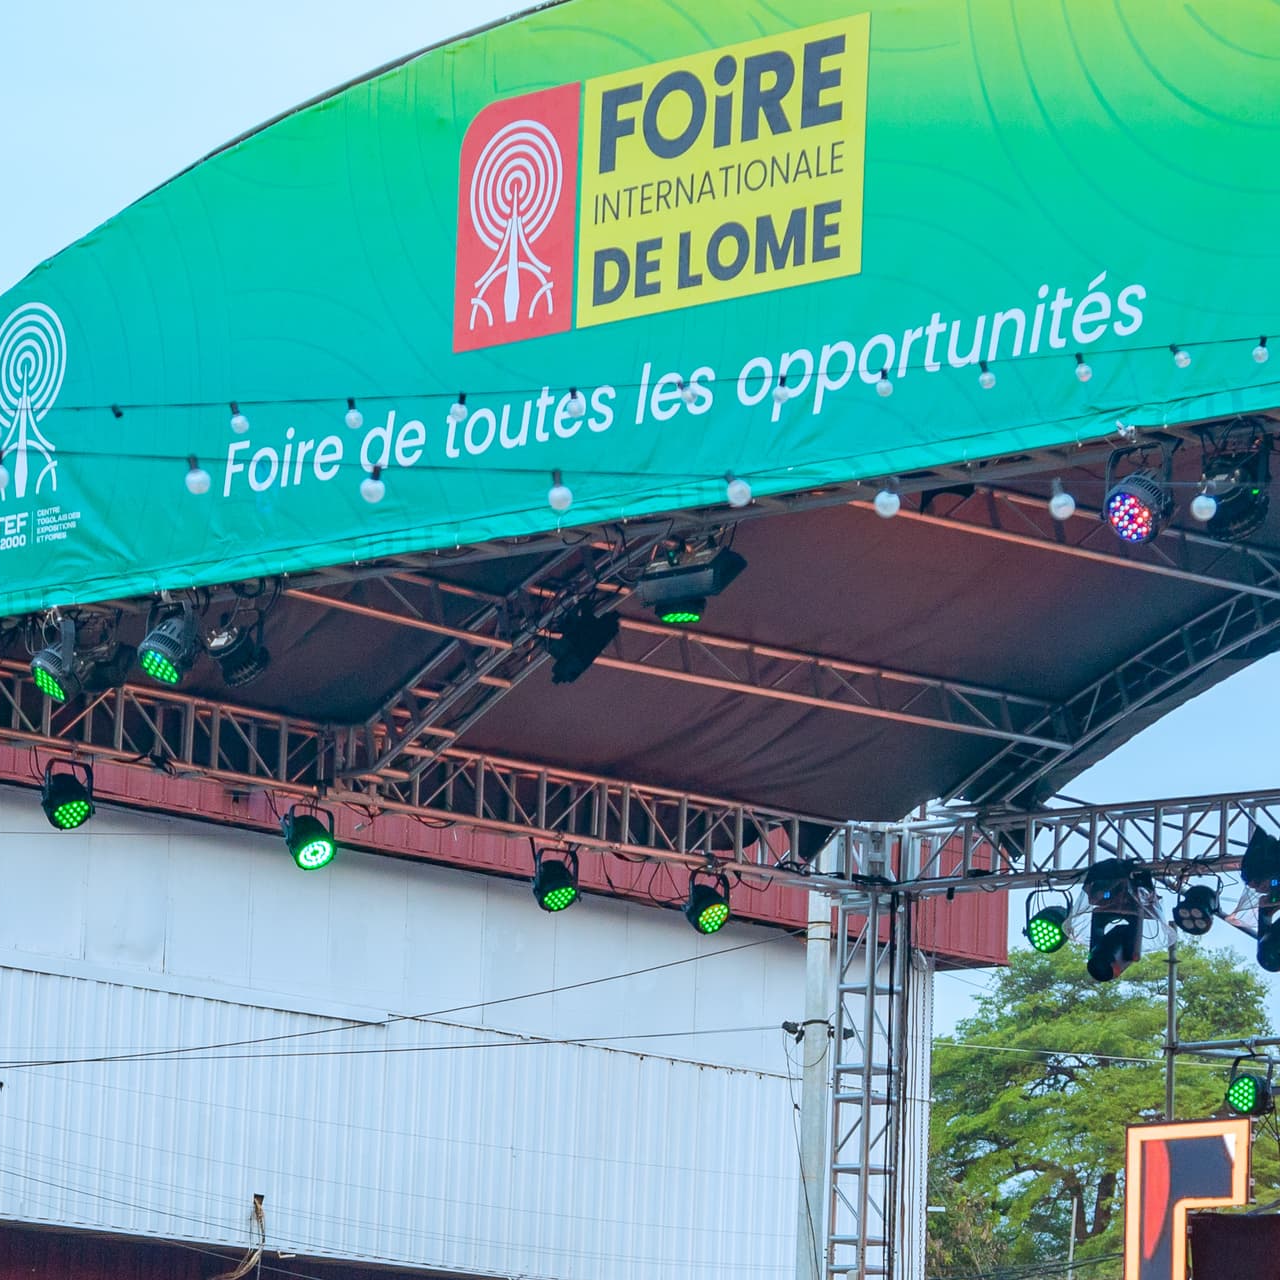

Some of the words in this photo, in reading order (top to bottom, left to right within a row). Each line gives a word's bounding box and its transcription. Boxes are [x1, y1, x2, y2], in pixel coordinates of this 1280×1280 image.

[593, 140, 845, 225] INTERNATIONALE
[592, 235, 663, 308] DE
[677, 199, 843, 290] LOME
[223, 427, 344, 497] Foire
[360, 411, 426, 472] de
[445, 386, 616, 459] toutes
[635, 362, 715, 425] les
[736, 271, 1147, 423] opportunités
